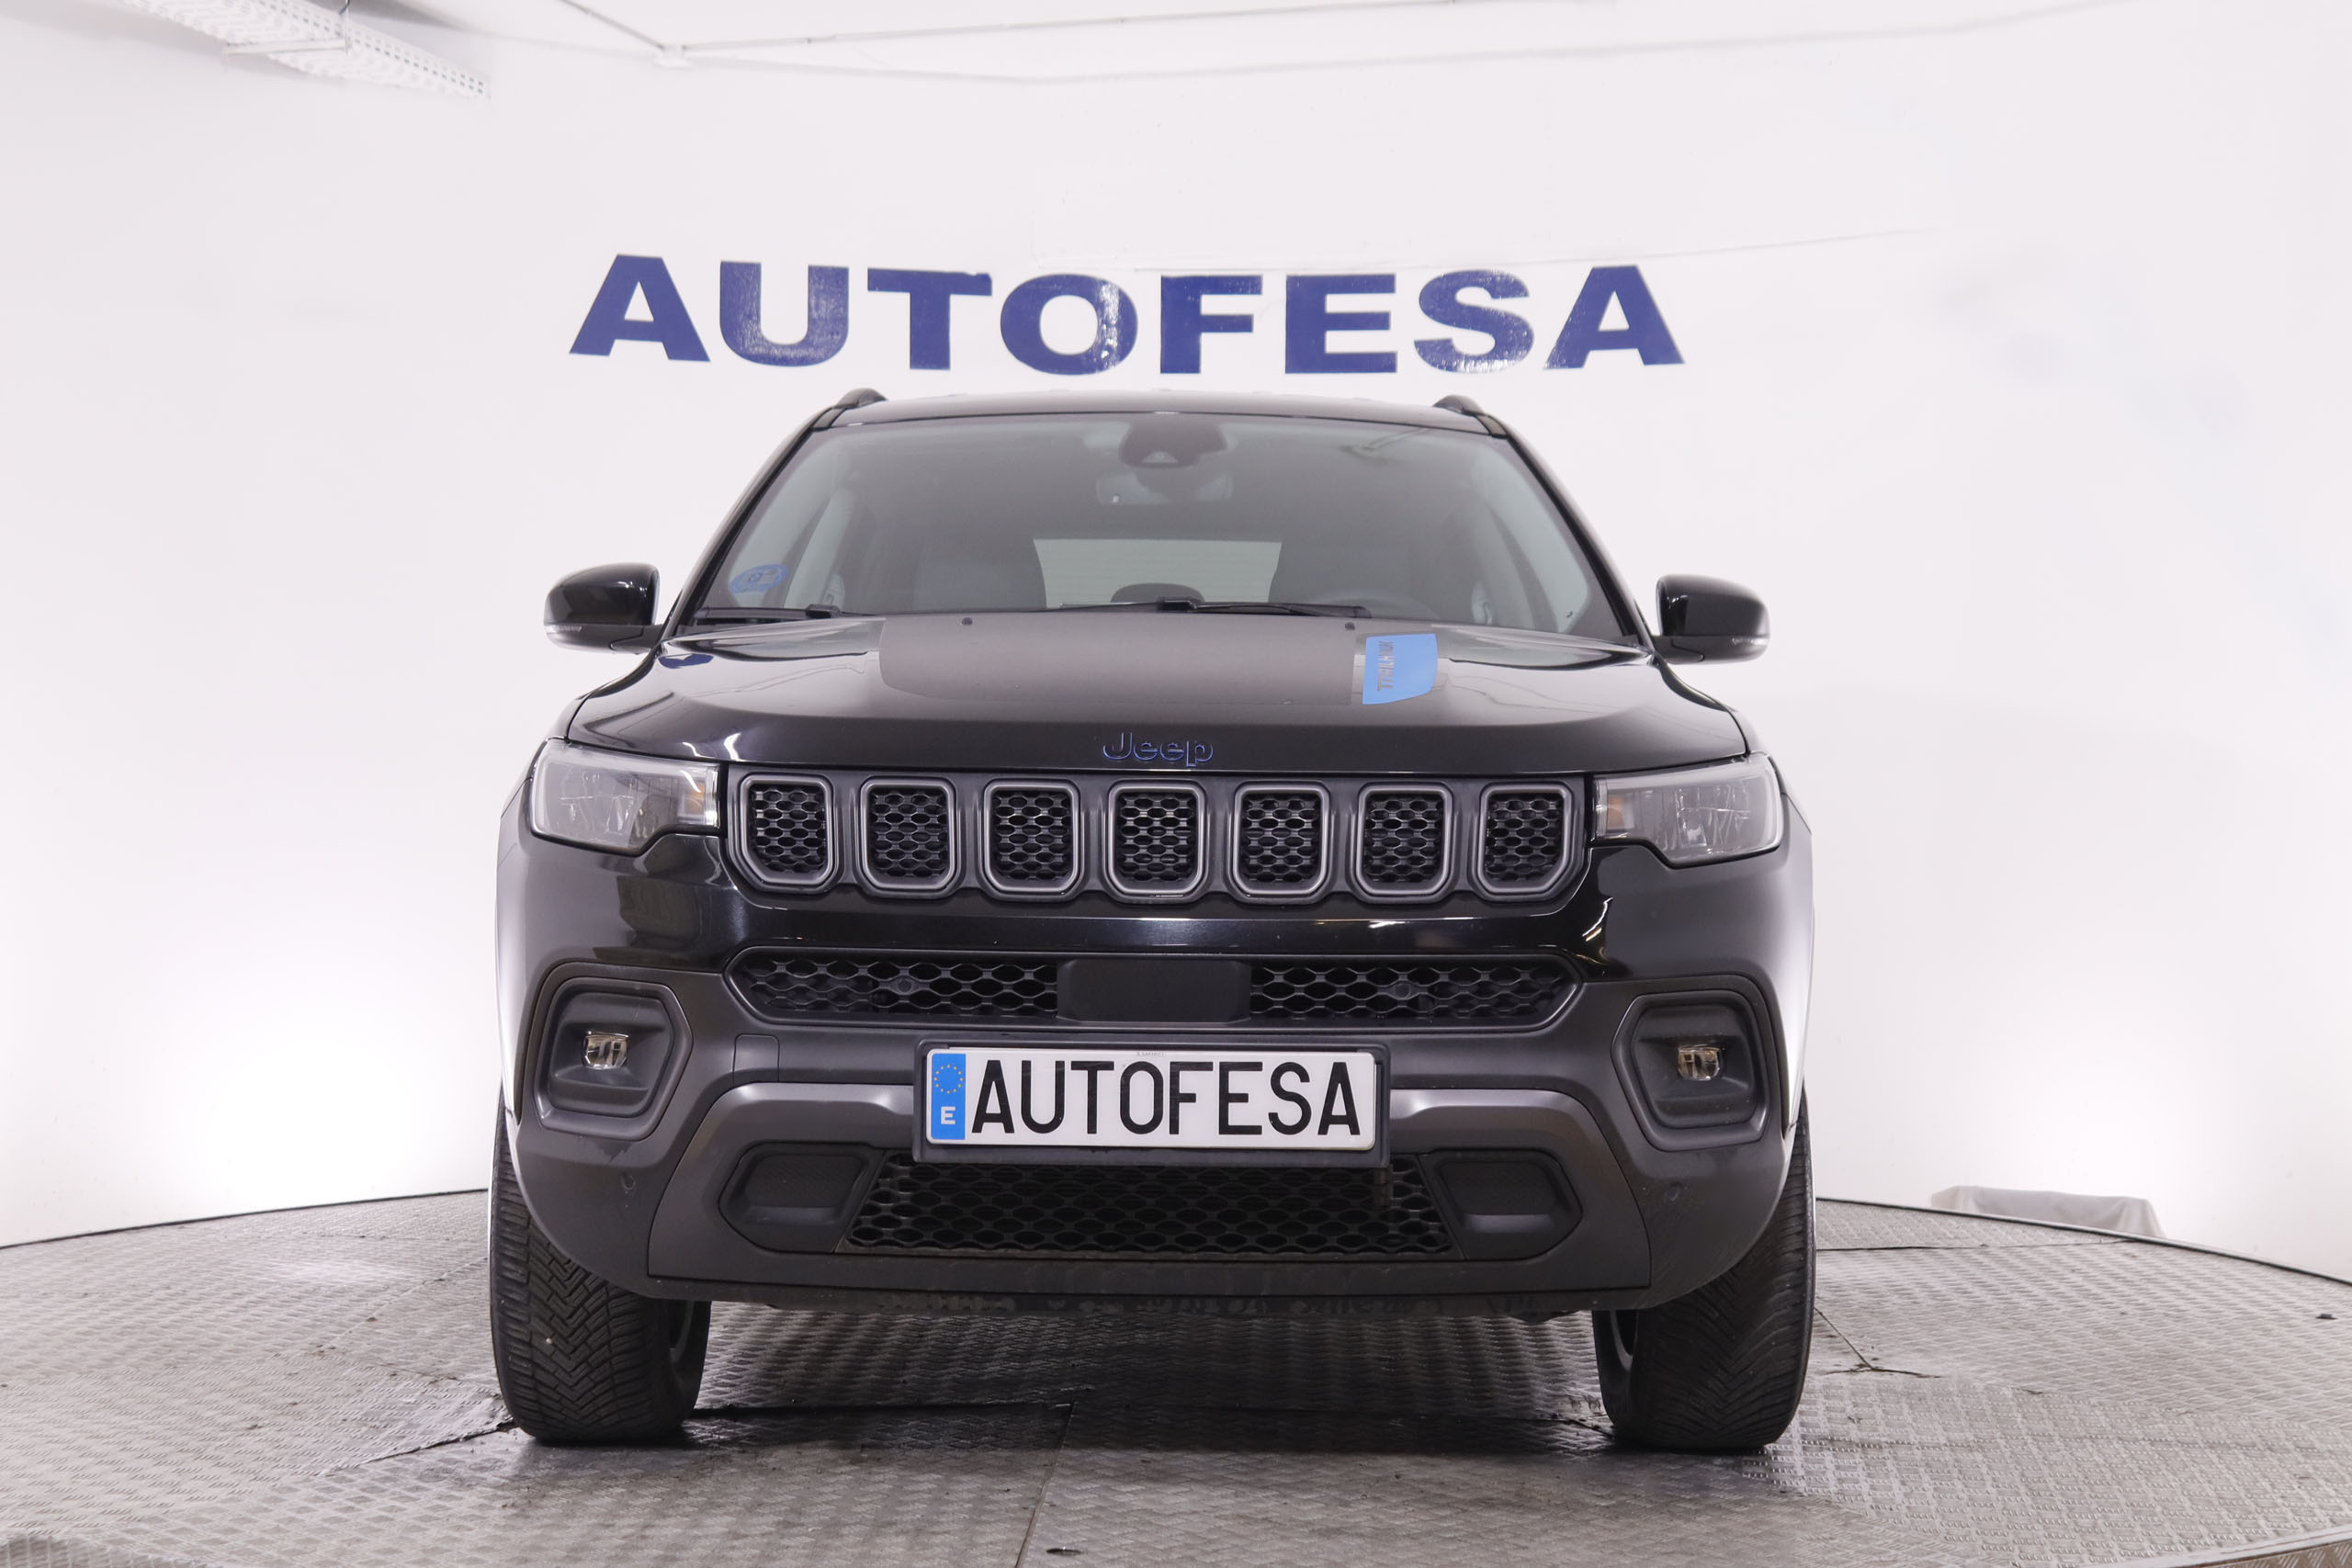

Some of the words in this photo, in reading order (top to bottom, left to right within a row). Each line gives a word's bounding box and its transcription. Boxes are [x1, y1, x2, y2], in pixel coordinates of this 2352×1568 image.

[570, 254, 1684, 376] AUTOFESA
[1102, 732, 1214, 767] Jeep
[941, 1106, 956, 1125] E
[971, 1059, 1361, 1136] AUTOFESA
